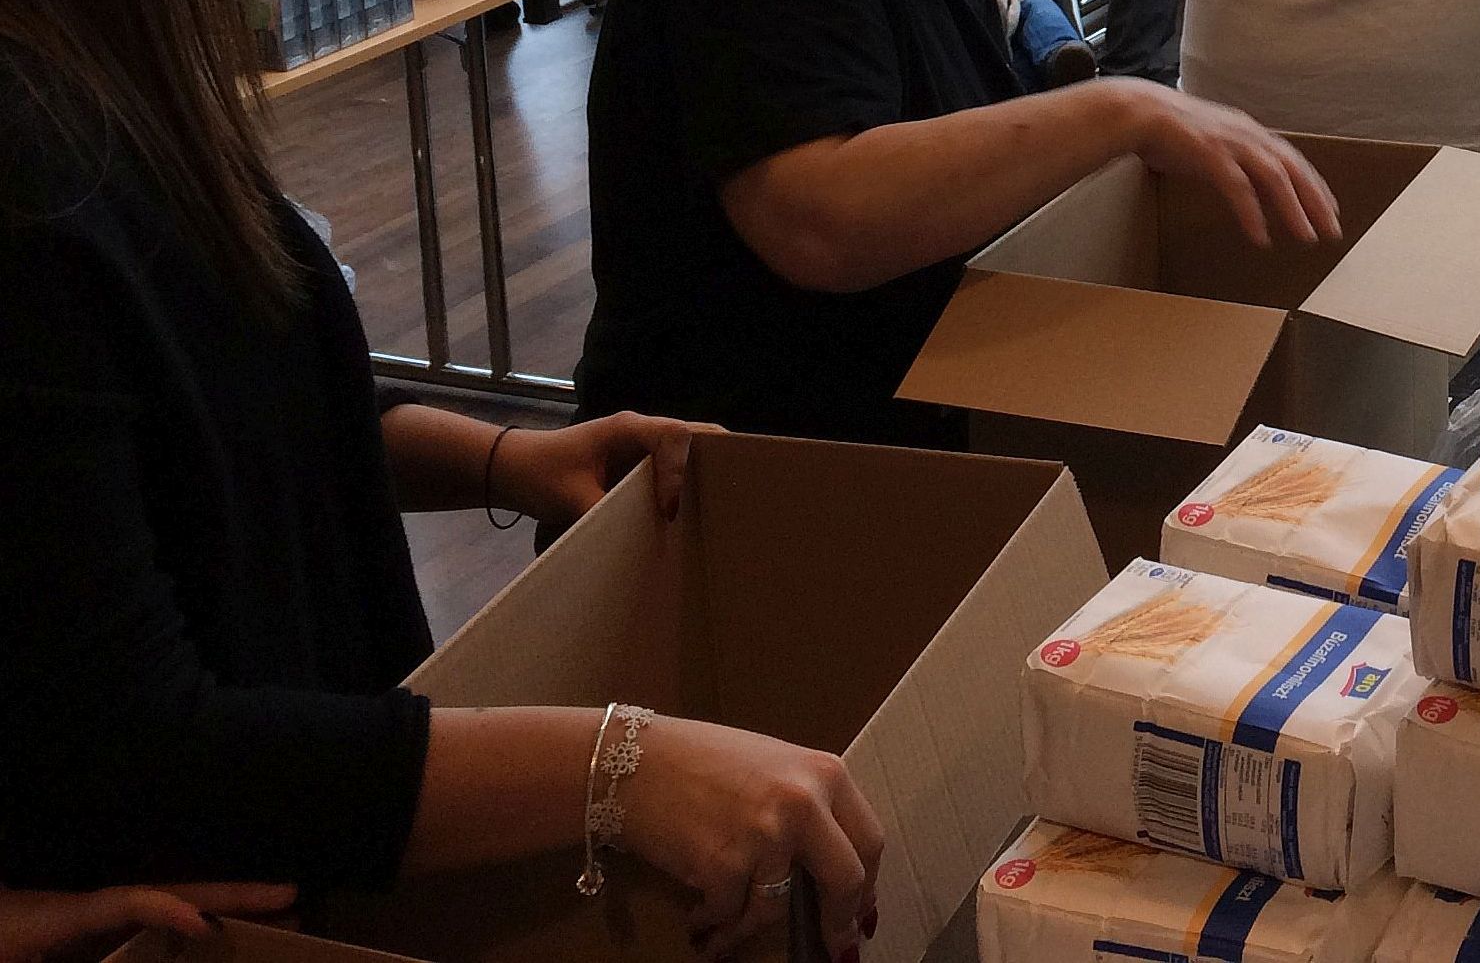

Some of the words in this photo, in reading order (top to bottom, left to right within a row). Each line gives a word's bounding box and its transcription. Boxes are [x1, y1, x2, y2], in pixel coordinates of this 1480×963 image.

[1181, 503, 1211, 526] 1kg
[1044, 640, 1076, 667] 1kg
[1272, 631, 1348, 700] Búzafinomliszt
[1355, 672, 1381, 694] aro
[1421, 698, 1451, 723] 1kg
[1000, 858, 1032, 887] 1kg
